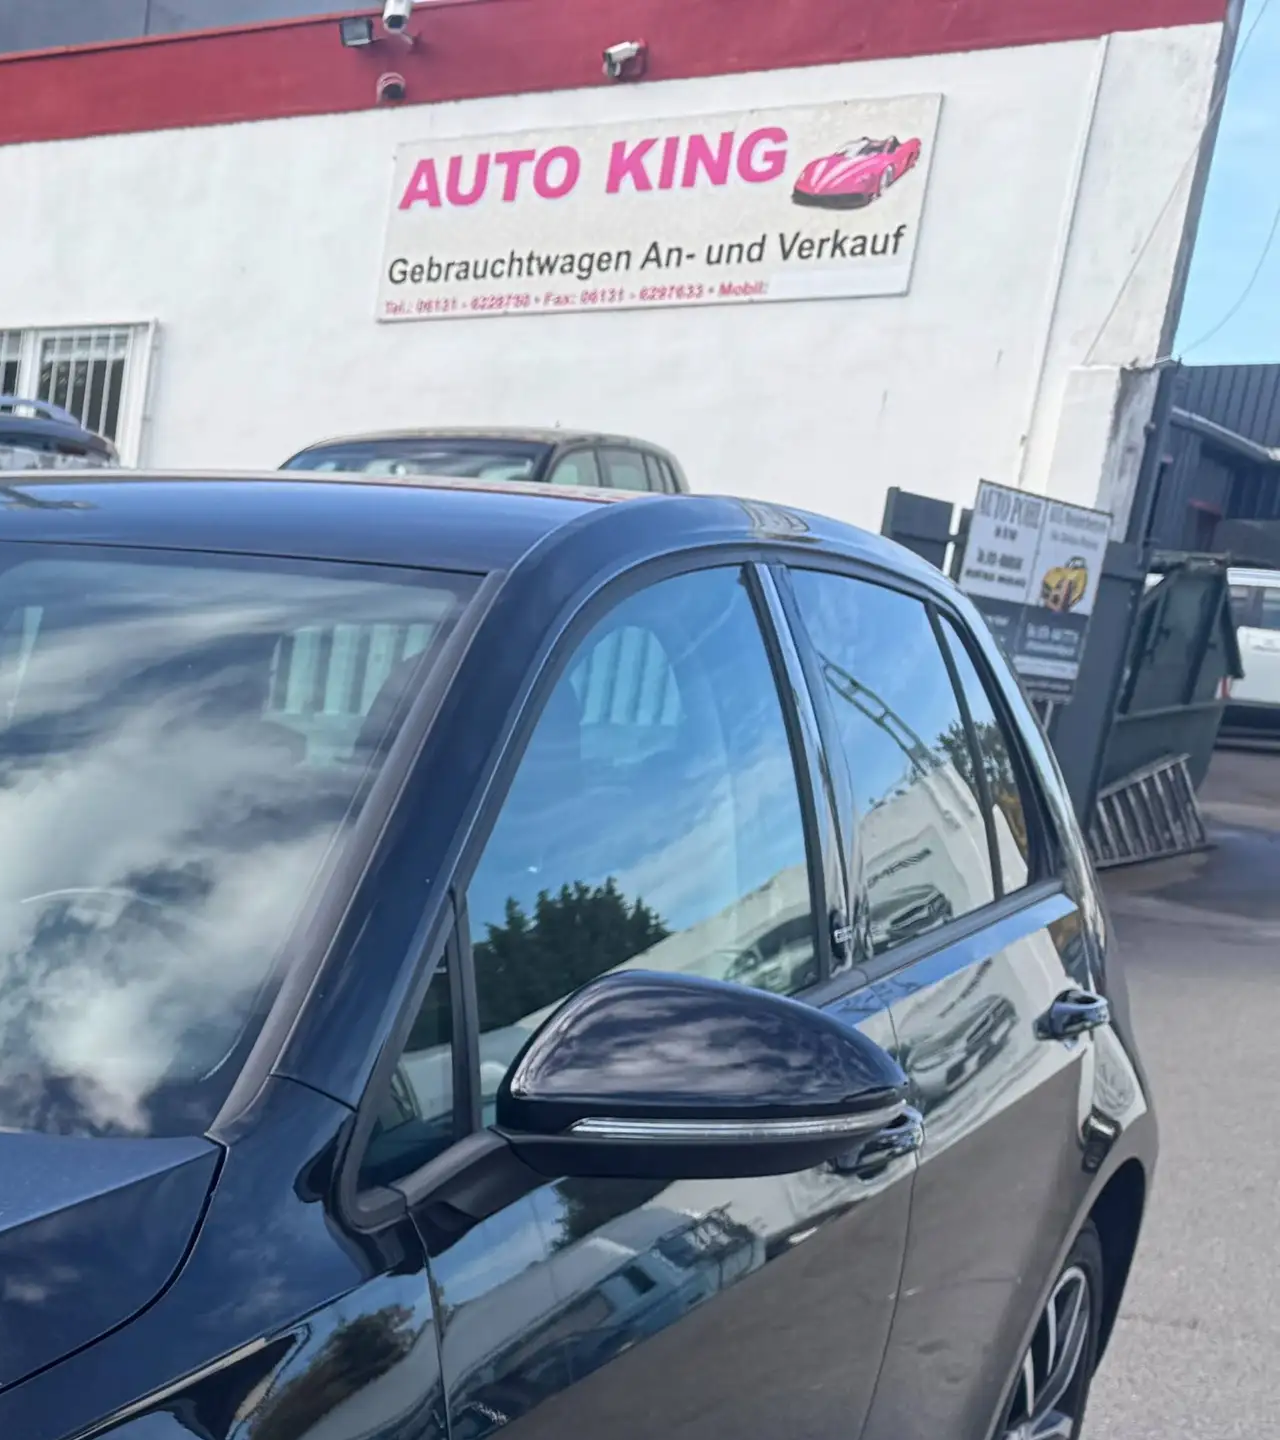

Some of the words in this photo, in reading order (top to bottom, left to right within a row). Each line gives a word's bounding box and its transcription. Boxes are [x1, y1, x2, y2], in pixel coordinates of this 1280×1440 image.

[398, 146, 580, 210] AUTO
[605, 127, 788, 193] KING
[388, 248, 632, 286] Gebrauchtwagen
[640, 241, 695, 270] An-
[705, 236, 765, 265] und
[778, 225, 907, 262] Verkauf
